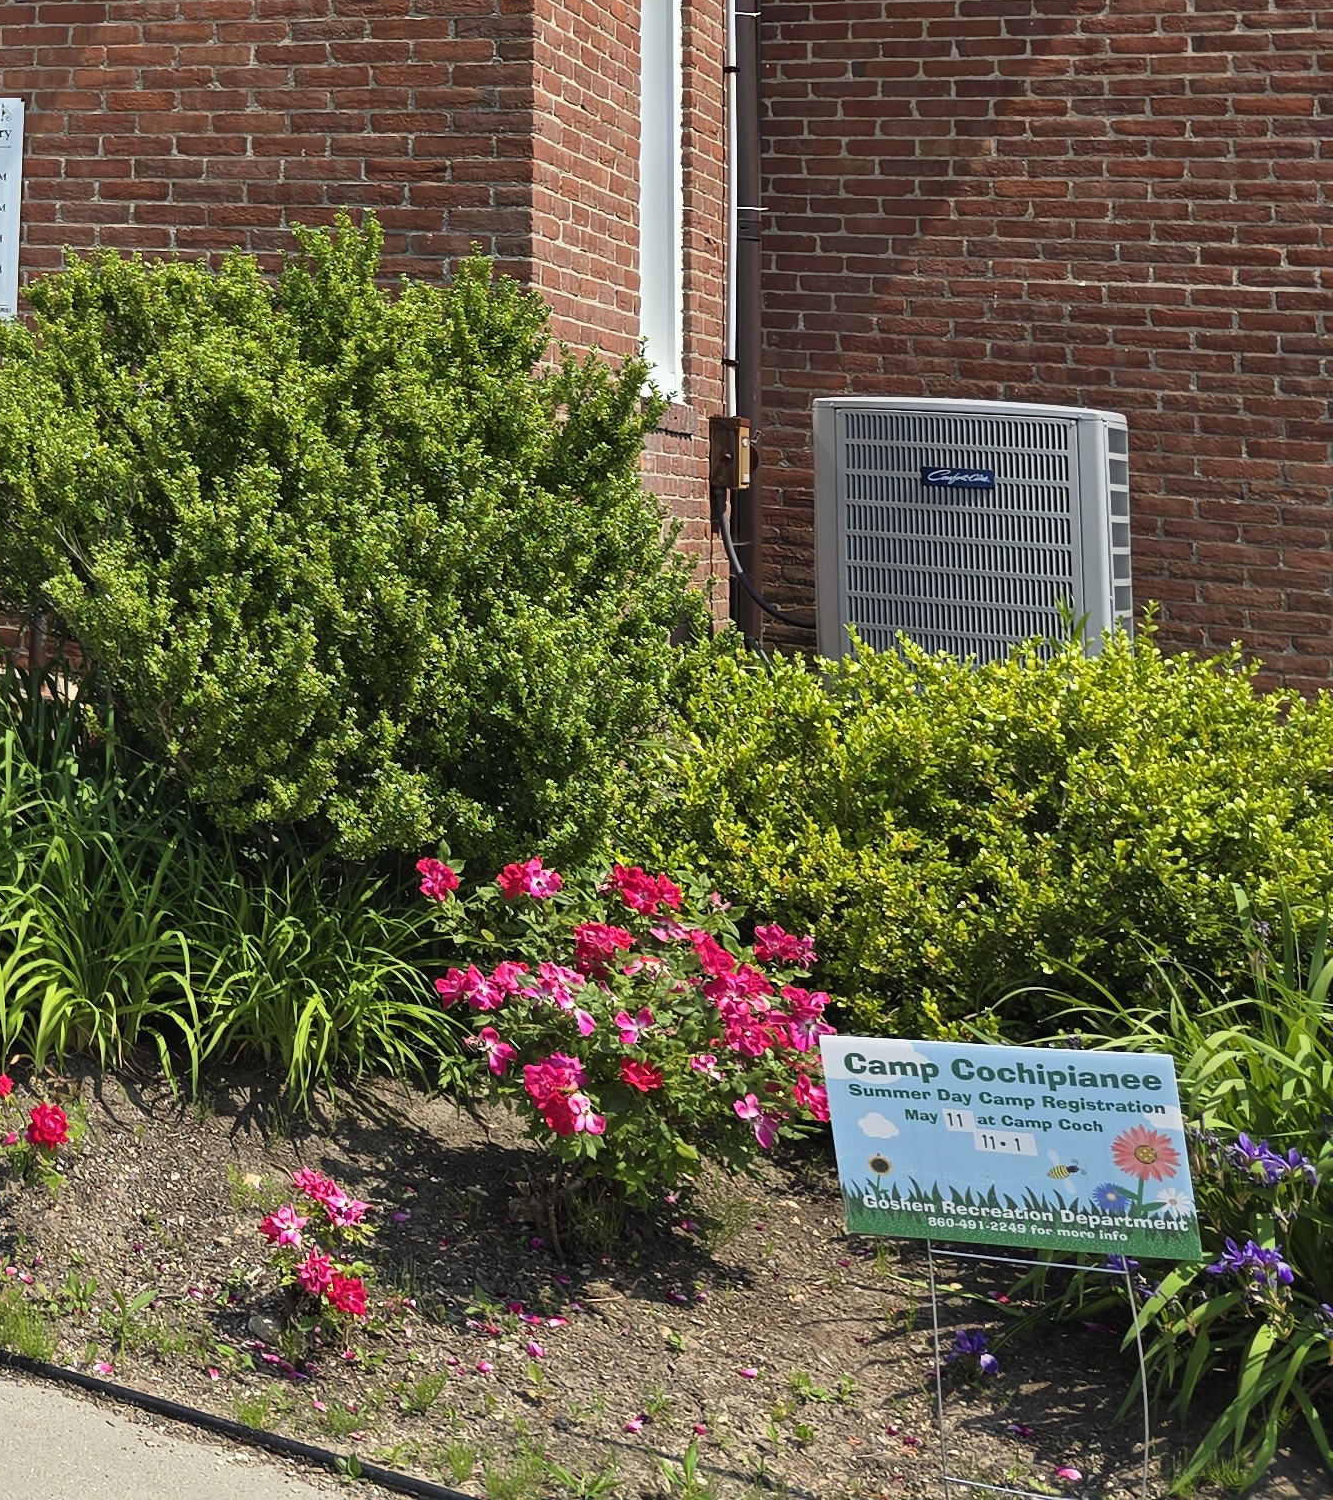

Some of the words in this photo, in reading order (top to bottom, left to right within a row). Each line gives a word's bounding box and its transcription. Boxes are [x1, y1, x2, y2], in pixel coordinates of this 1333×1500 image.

[844, 1052, 940, 1084] Camp
[951, 1058, 1162, 1092] Cochipianee
[848, 1083, 932, 1100] Summer
[937, 1088, 973, 1106] Day
[979, 1091, 1035, 1111] Camp
[1042, 1095, 1166, 1115] Registration
[904, 1108, 938, 1125] May
[947, 1112, 964, 1128] 11
[977, 1115, 996, 1126] at
[1001, 1115, 1053, 1132] Camp
[1058, 1118, 1104, 1133] Coch
[862, 1194, 935, 1213] Goshen
[941, 1200, 1054, 1222] Recreation
[1060, 1209, 1189, 1232] Department
[928, 1216, 1027, 1234] 860-491-2249
[1030, 1225, 1053, 1236] for
[1057, 1228, 1096, 1239] more
[1099, 1230, 1129, 1242] info
